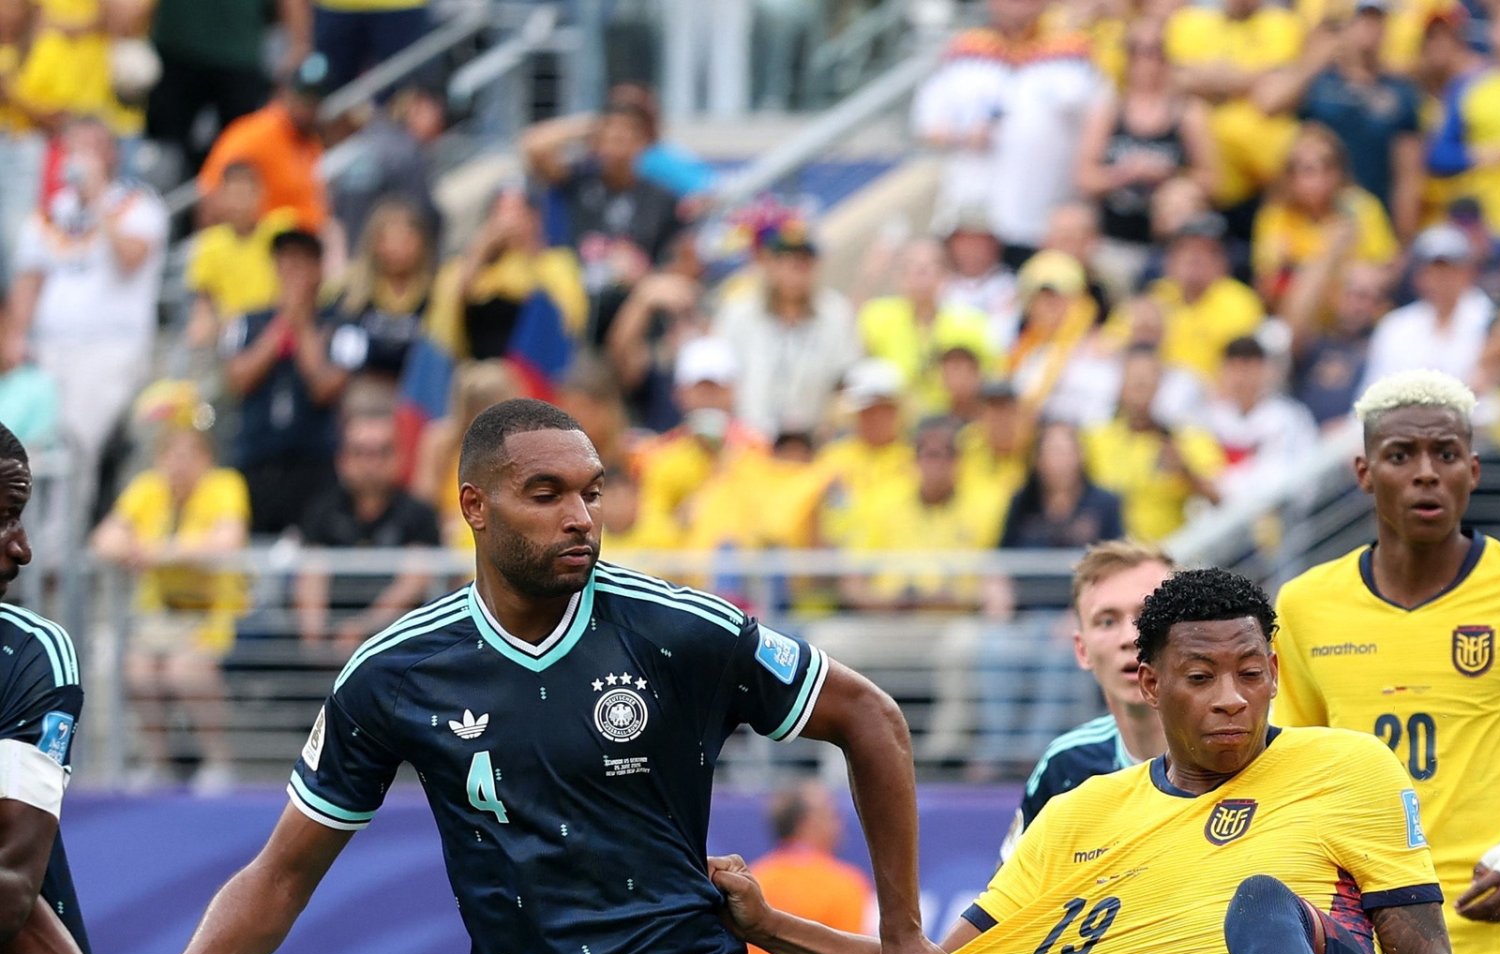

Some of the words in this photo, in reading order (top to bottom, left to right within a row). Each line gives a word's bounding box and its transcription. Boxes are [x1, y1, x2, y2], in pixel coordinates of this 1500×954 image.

[1312, 642, 1377, 657] marathon
[1375, 712, 1437, 781] 20
[466, 751, 510, 824] 4
